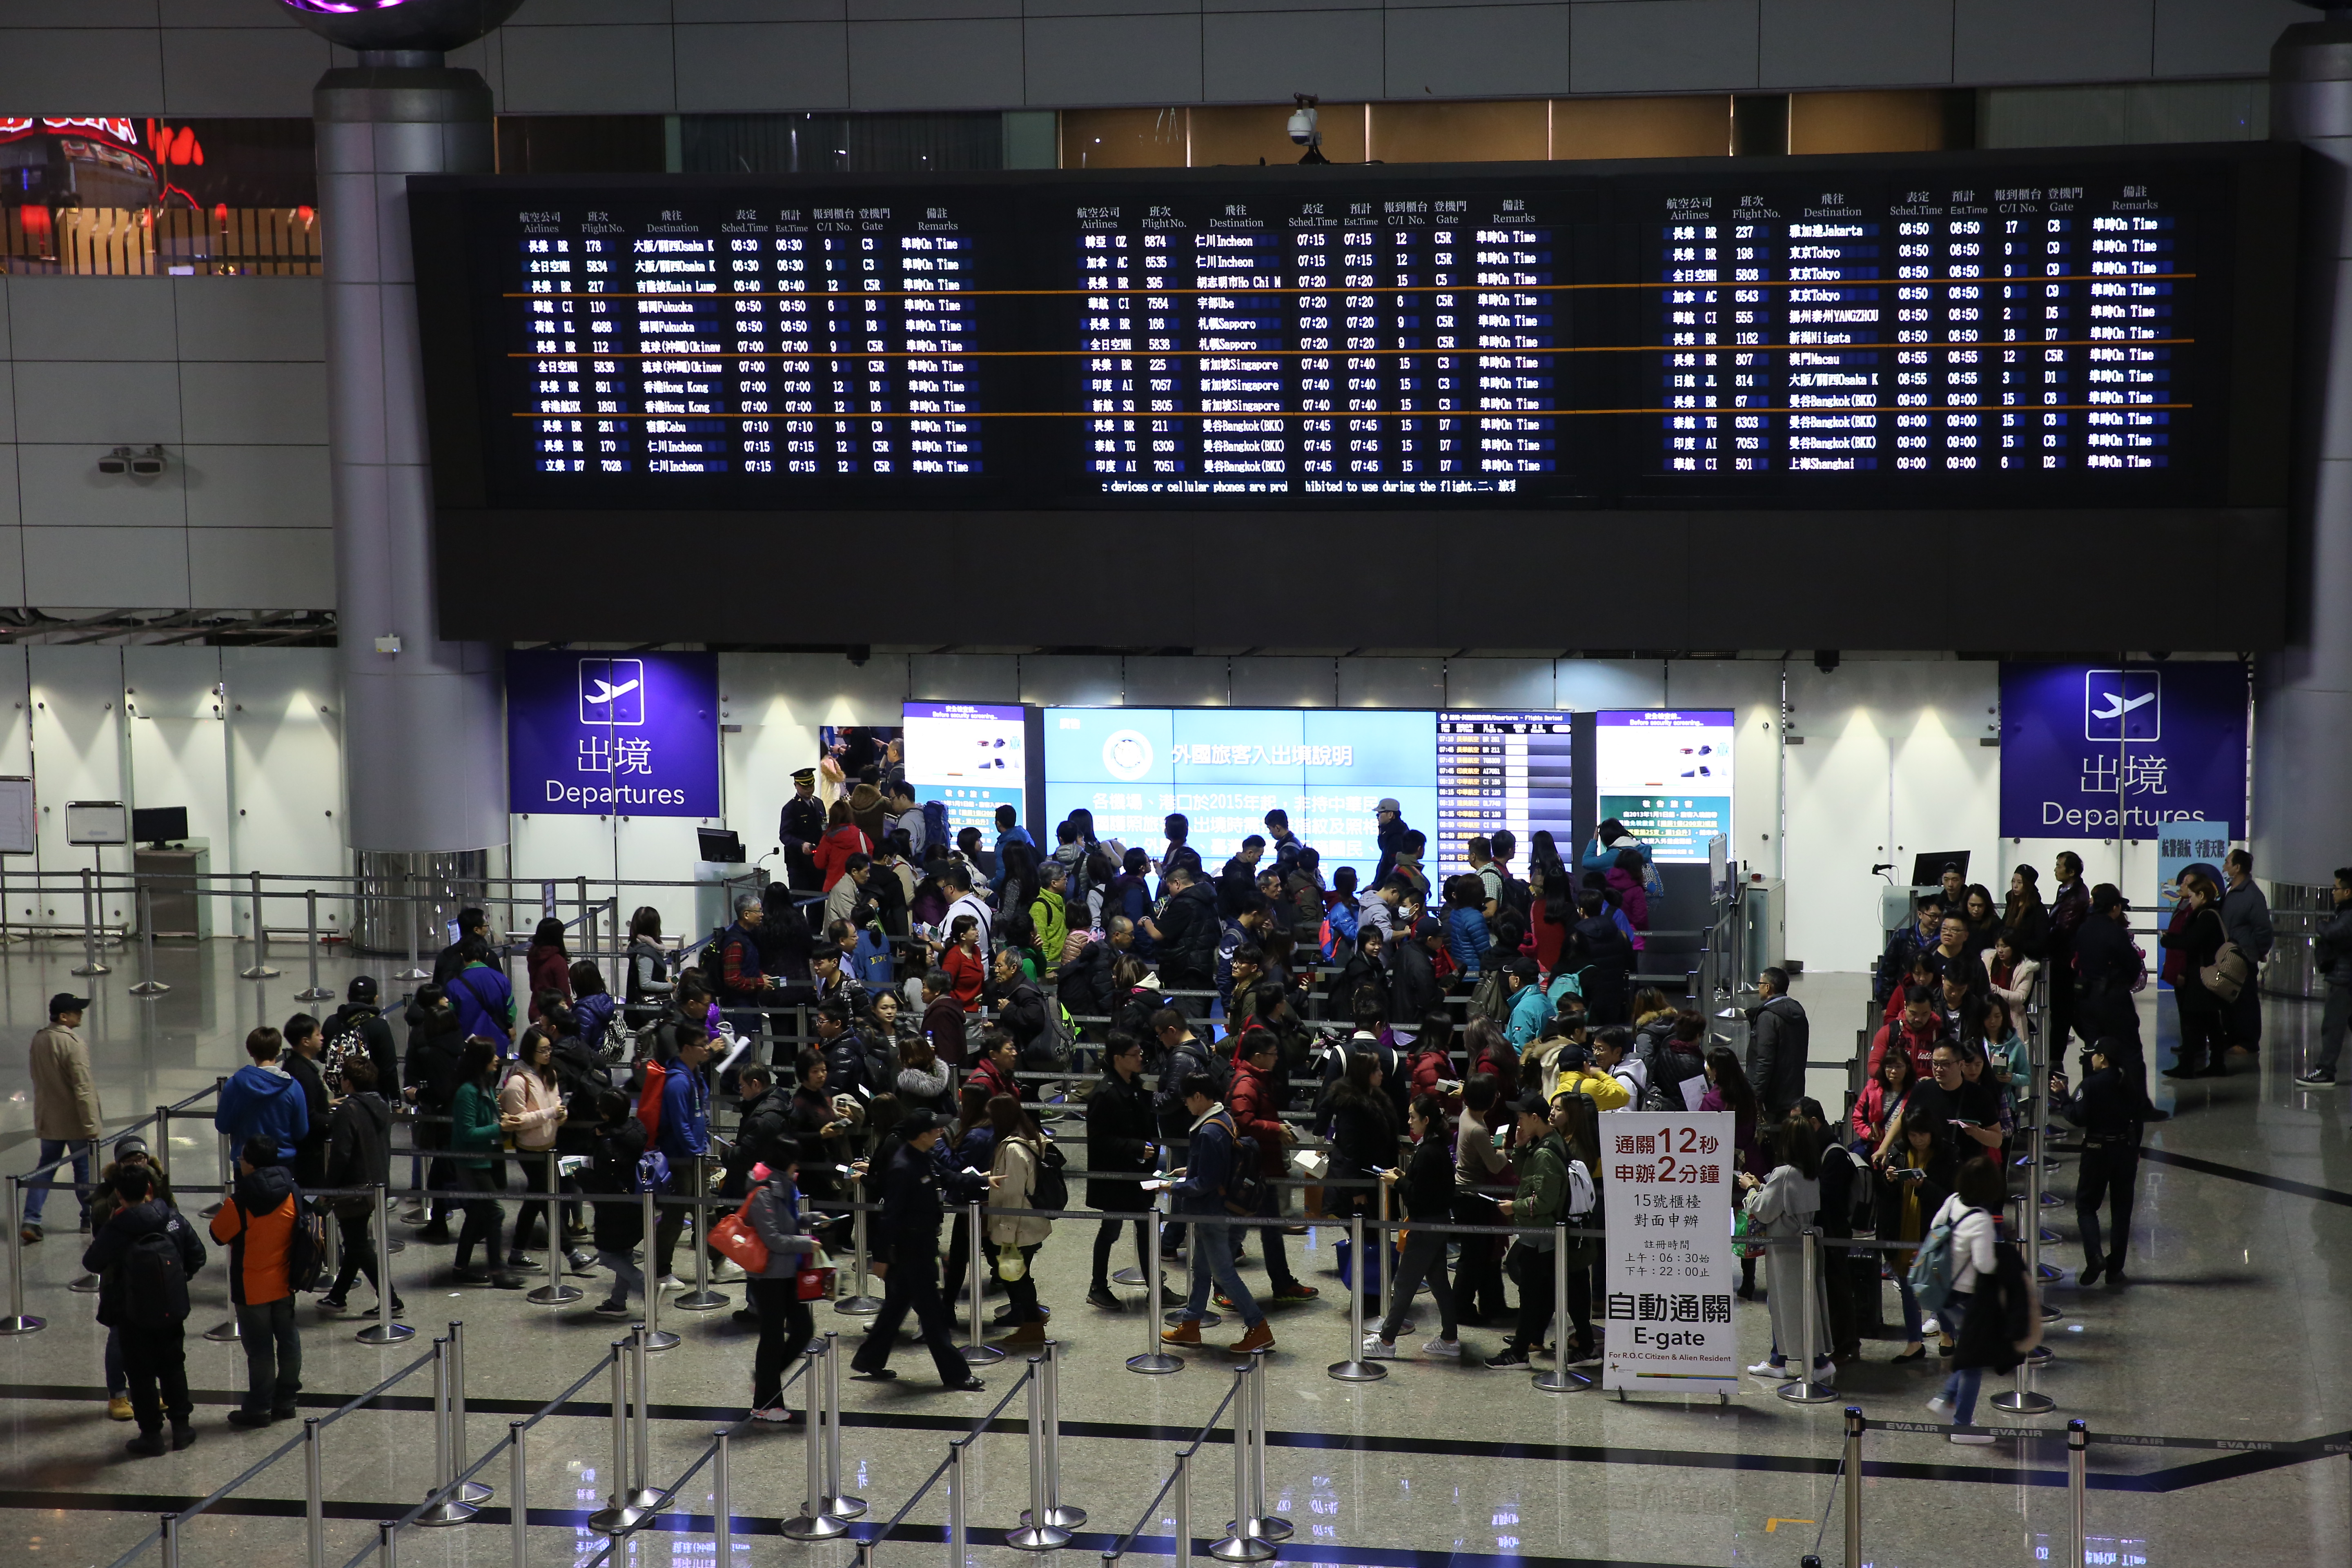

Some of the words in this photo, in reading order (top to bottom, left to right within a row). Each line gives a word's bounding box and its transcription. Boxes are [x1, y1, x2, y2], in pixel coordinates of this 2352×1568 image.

[520, 212, 560, 222] 航空公司
[588, 212, 608, 221] 班次
[662, 210, 682, 220] 飛往
[737, 209, 756, 220] 表定
[781, 210, 800, 220] 預計
[813, 208, 854, 219] 報到櫃台
[859, 208, 890, 219] 登機門
[927, 208, 947, 218] 備註
[525, 223, 559, 232] Airlines
[582, 224, 607, 234] Flight
[609, 224, 624, 232] No.
[647, 223, 698, 232] Destination
[722, 223, 768, 232] Sched.Time
[817, 223, 832, 231] C/I
[836, 222, 852, 231] No.
[918, 221, 958, 230] Remarks
[1706, 248, 1716, 260] BR
[1737, 247, 1753, 259] 198
[1900, 245, 1928, 256] 08:50
[1950, 243, 1979, 256] 08:50
[2005, 243, 2011, 254] 9
[2048, 242, 2059, 254] C9
[2133, 240, 2156, 252] Time
[1121, 359, 1132, 370] BR
[1150, 359, 1166, 370] 225
[1302, 359, 1328, 370] 07:40
[1348, 358, 1375, 369] 07:40
[1399, 358, 1410, 369] 15
[1438, 357, 1449, 368] C3
[1516, 356, 1538, 368] Time
[568, 381, 579, 392] BR
[596, 381, 611, 392] 891
[687, 381, 708, 393] Kong
[740, 381, 766, 392] 07:00
[785, 381, 810, 392] 07:00
[833, 381, 843, 392] 12
[870, 381, 880, 392] D6
[943, 381, 964, 392] Time
[574, 460, 584, 471] B7
[601, 461, 621, 471] 7028
[746, 461, 771, 472] 07:15
[789, 461, 815, 472] 07:15
[838, 461, 848, 472] 12
[874, 461, 890, 472] C5R
[947, 461, 968, 472] Time
[1111, 481, 1148, 492] devices
[1167, 481, 1209, 492] cellular
[1214, 481, 1245, 493] phones
[1346, 482, 1358, 492] to
[1383, 481, 1415, 492] during
[1419, 481, 1436, 492] the
[577, 736, 652, 775] 出境
[1171, 744, 1353, 766] 外國旅客入出境說明
[2081, 754, 2167, 795] 出境
[546, 780, 685, 808] Departures
[2042, 802, 2204, 832] Departures
[1615, 1127, 1719, 1154] 通關12秒
[1615, 1156, 1719, 1183] 申辦2分鐘
[1634, 1213, 1698, 1228] 對面申辦
[1644, 1240, 1689, 1250] 註冊時間
[1608, 1292, 1731, 1323] 自動通關
[1635, 1327, 1705, 1350] E-gate
